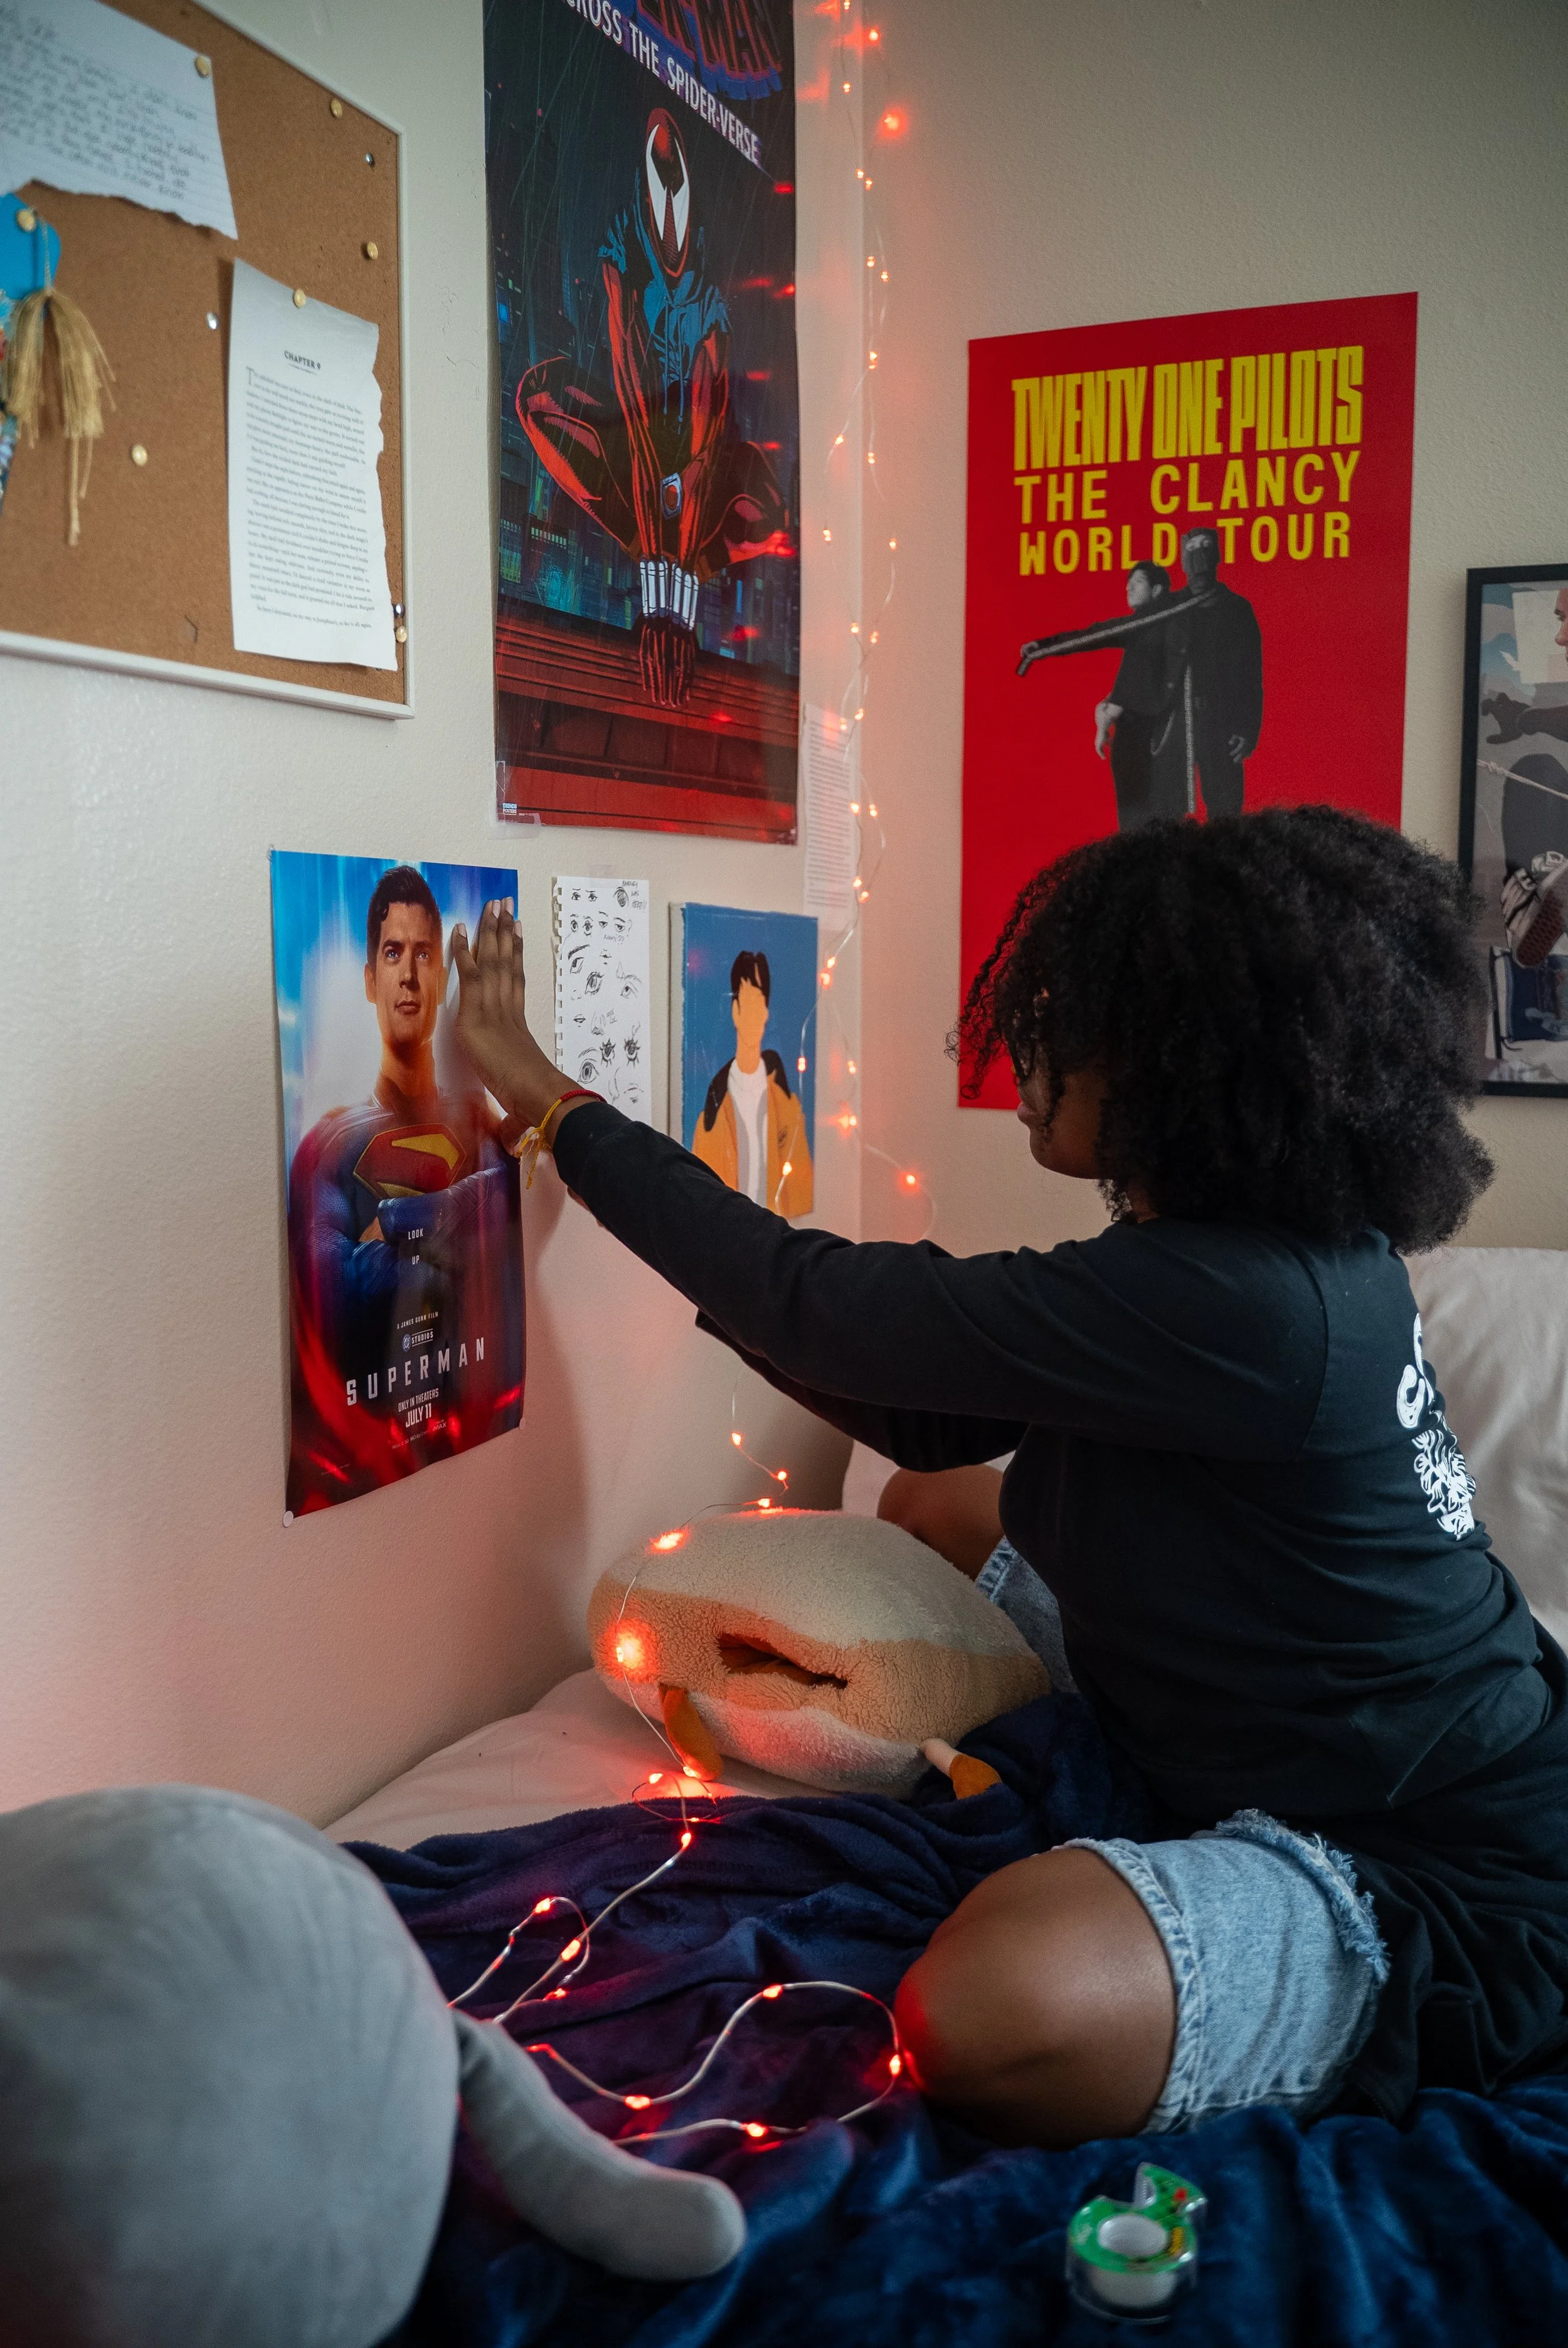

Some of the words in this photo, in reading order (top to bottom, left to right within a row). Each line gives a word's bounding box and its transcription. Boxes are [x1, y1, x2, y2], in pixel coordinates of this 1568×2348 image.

[567, 0, 622, 45] OSS
[629, 21, 659, 76] THE
[667, 56, 759, 164] SPIDER-VERSE
[283, 350, 315, 369] CHAPTER
[1011, 366, 1148, 471] TWENTY
[1152, 358, 1224, 459] ONE
[1229, 346, 1364, 453] PILOTS
[1014, 470, 1108, 524] THE
[1150, 450, 1361, 514] CLANCY
[1019, 522, 1179, 576] WORLD
[1217, 511, 1351, 564] TOUR
[408, 1228, 423, 1240] LOOK
[412, 1255, 420, 1265] UP
[401, 1318, 414, 1328] JAMES
[415, 1314, 426, 1323] GUNN
[428, 1311, 438, 1319] FILM
[411, 1331, 434, 1344] STUDIOS
[346, 1337, 485, 1406] SUPERMAN
[398, 1399, 409, 1412] ONLY
[410, 1397, 415, 1406] IN
[416, 1388, 438, 1405] THEATERS
[405, 1406, 423, 1428] JULY
[425, 1403, 432, 1418] 11
